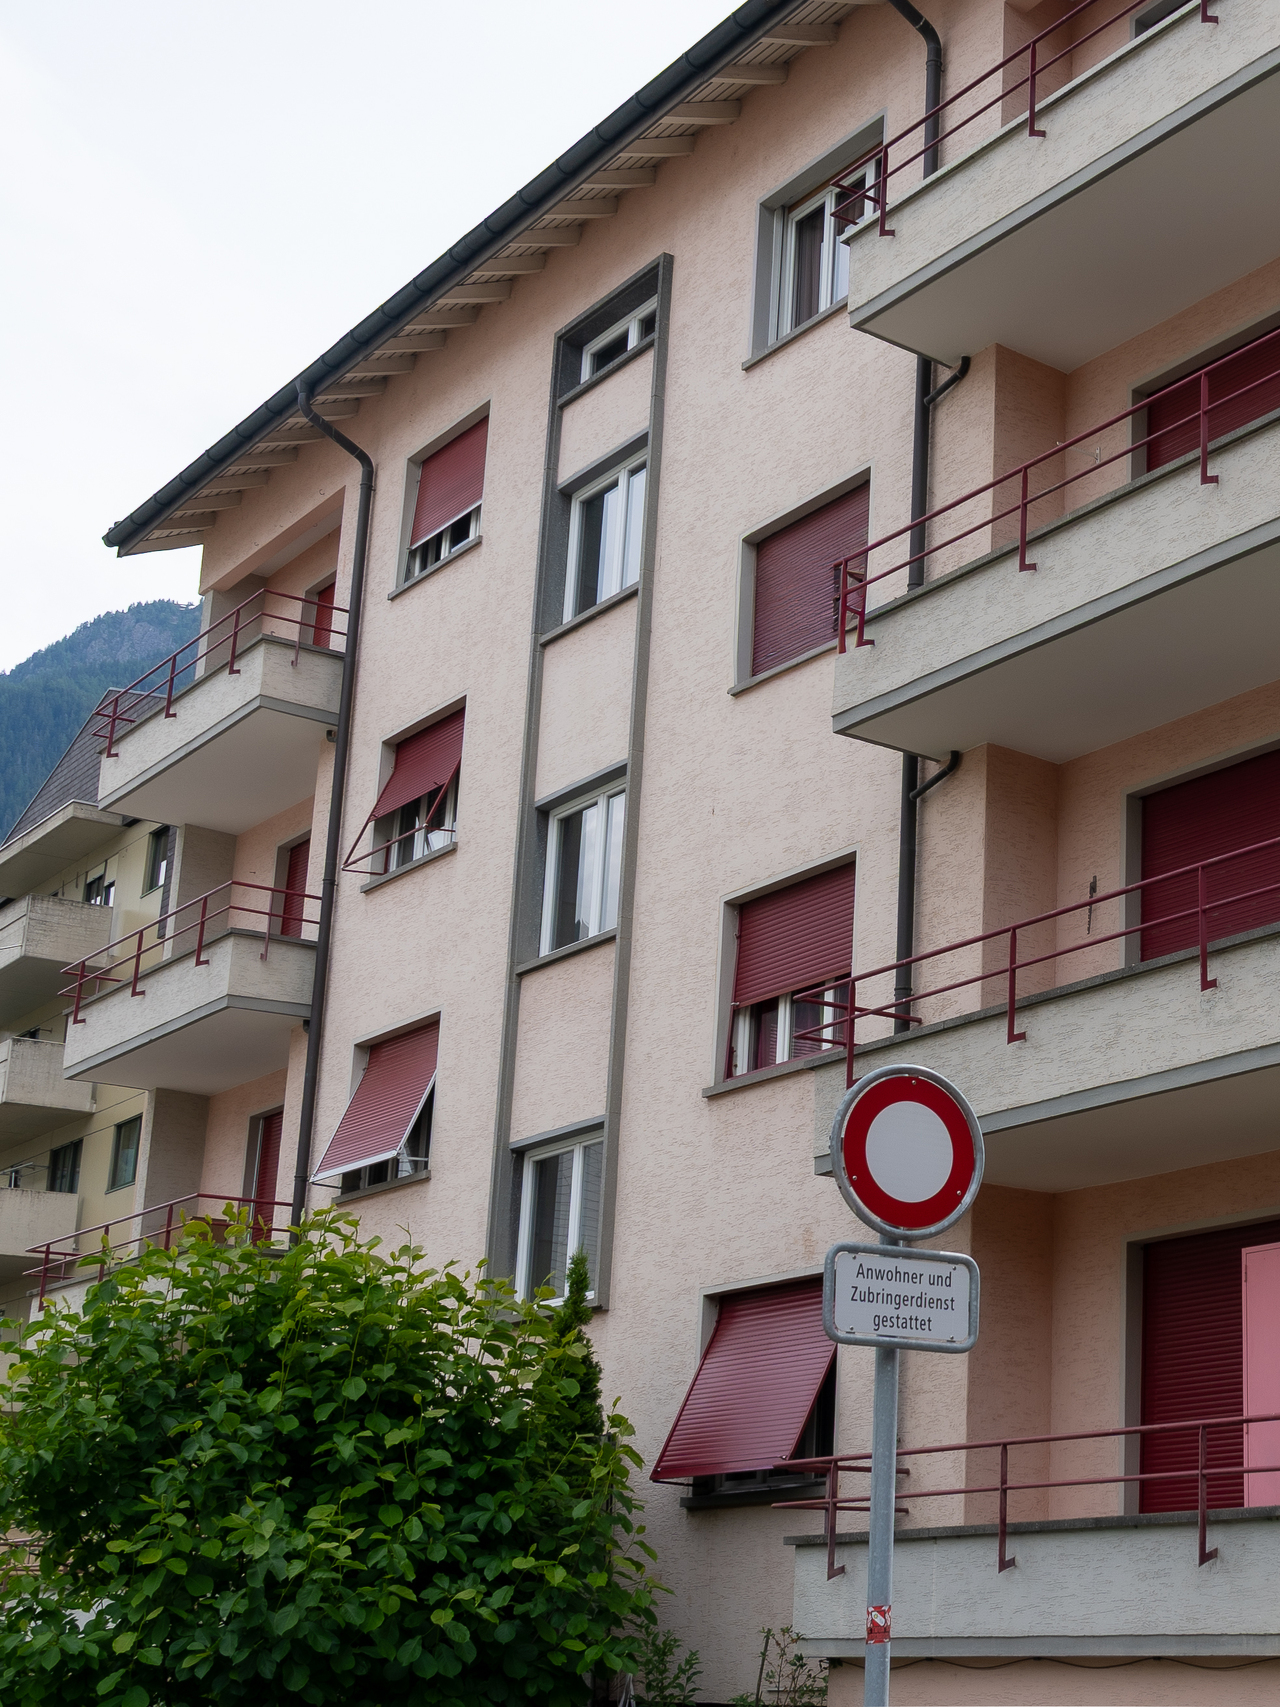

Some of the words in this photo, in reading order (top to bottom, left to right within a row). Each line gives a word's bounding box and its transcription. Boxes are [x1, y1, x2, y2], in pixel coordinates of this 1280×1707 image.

[856, 1263, 924, 1284] Anwohner
[928, 1272, 952, 1287] und
[850, 1286, 955, 1311] Zubringerdienst
[873, 1314, 932, 1331] gestattet
